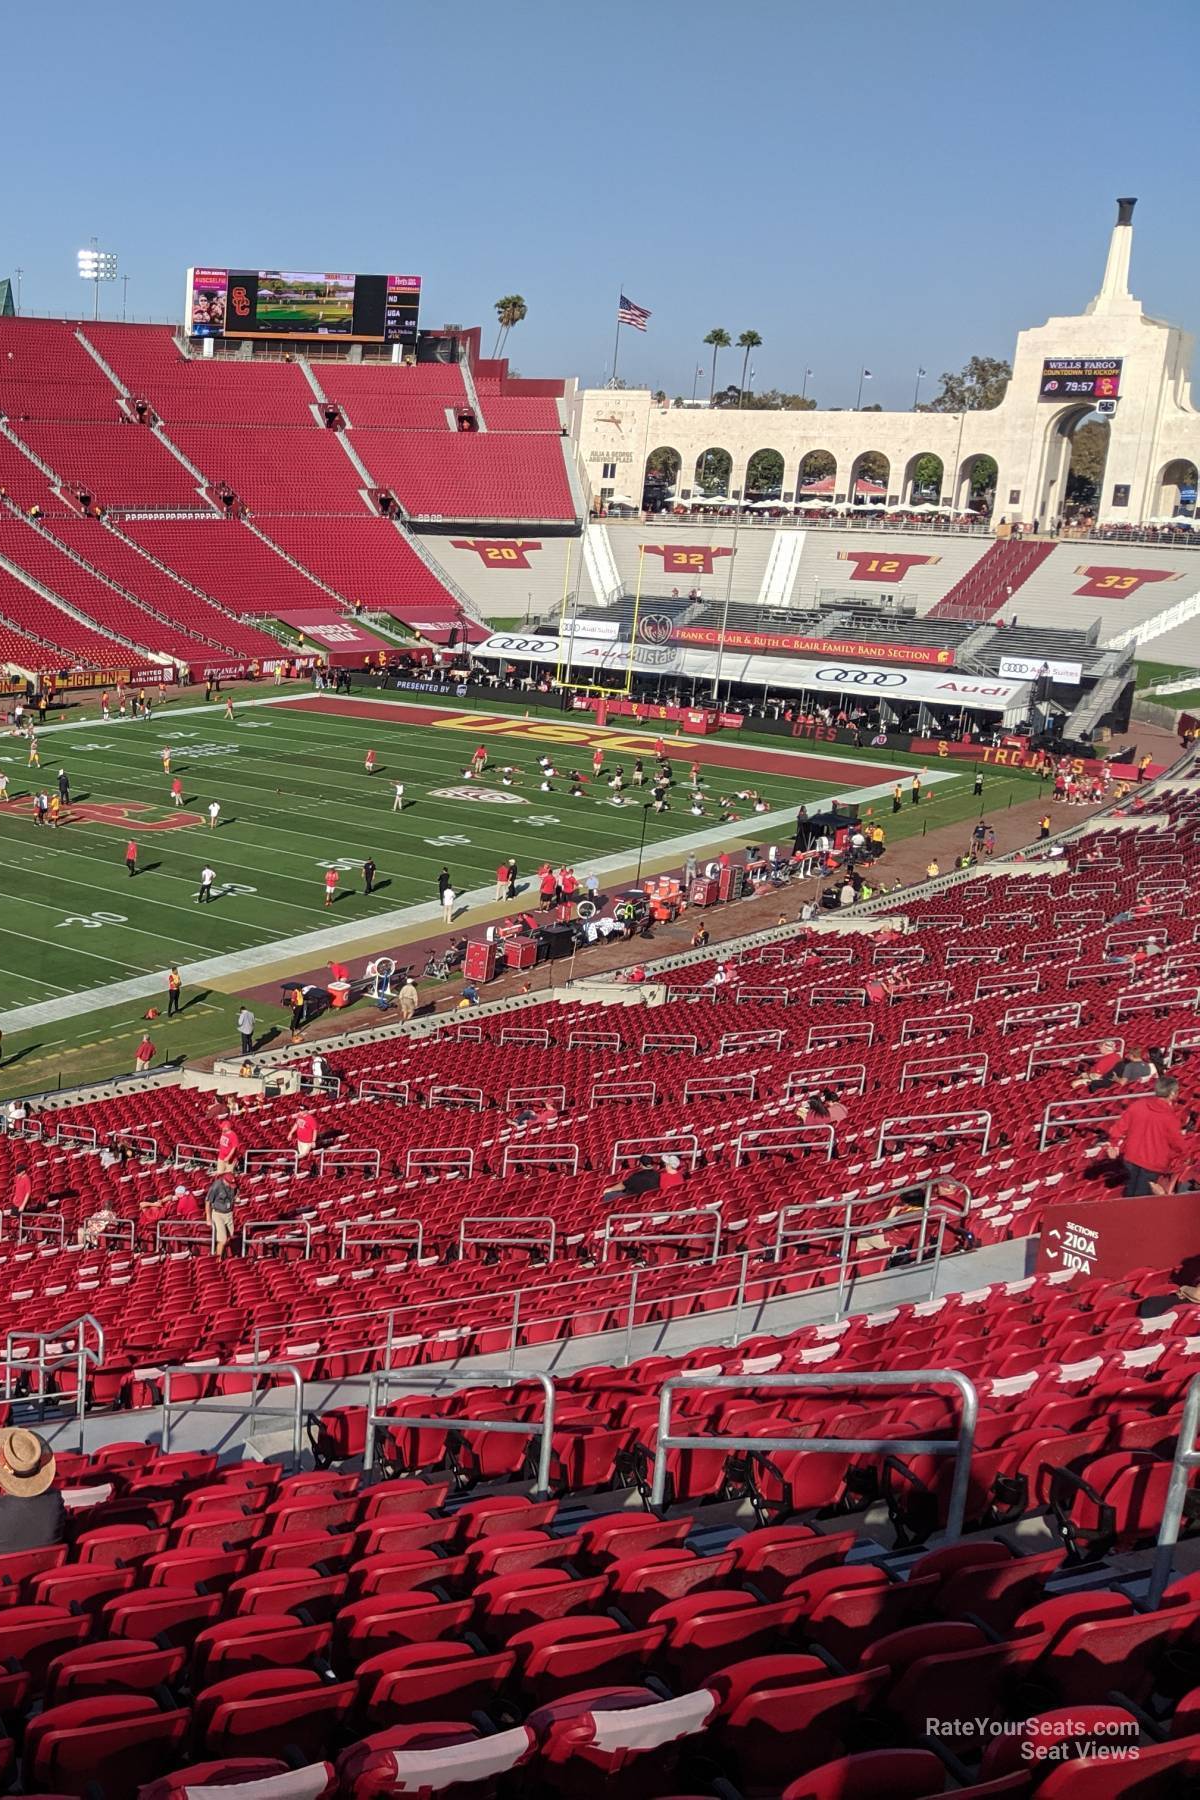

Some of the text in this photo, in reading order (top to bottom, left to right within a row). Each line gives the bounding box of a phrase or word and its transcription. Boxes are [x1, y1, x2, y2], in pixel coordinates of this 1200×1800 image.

[1049, 361, 1116, 369] WELLS FARGO
[1065, 381, 1094, 391] 79:57
[485, 548, 518, 560] 20
[672, 552, 705, 565] 32
[866, 560, 901, 573] 12
[1095, 575, 1138, 590] 33
[299, 623, 359, 634] MUSCLE
[581, 625, 596, 633] Audi
[676, 630, 704, 640] FRANK
[754, 636, 779, 647] RUTH
[793, 640, 820, 650] BLAIR
[822, 642, 856, 654] FAMILY
[858, 645, 885, 656] BAND
[887, 649, 930, 660] SECTION
[396, 681, 439, 693] PRESENTED
[440, 685, 450, 693] BY
[935, 682, 1012, 697] Audi
[432, 715, 699, 755] USC
[792, 725, 838, 742] UTES
[983, 747, 1084, 774] TROJS
[64, 911, 129, 929] 30
[1066, 1221, 1100, 1240] SECTIONS
[1063, 1232, 1096, 1256] 210A
[1062, 1252, 1091, 1275] 110A
